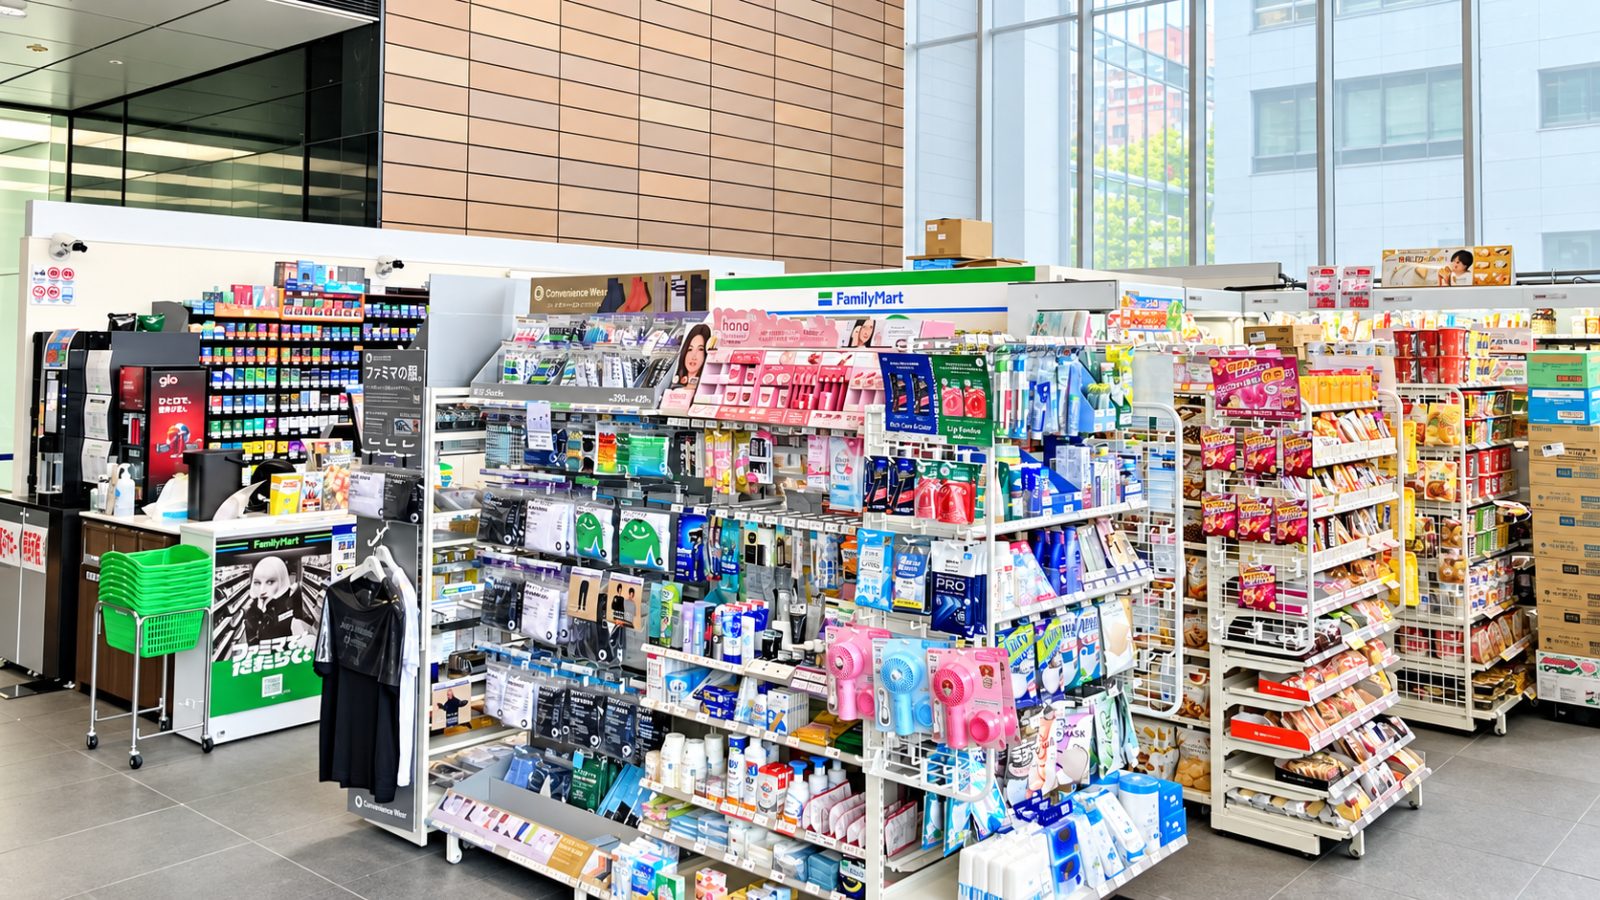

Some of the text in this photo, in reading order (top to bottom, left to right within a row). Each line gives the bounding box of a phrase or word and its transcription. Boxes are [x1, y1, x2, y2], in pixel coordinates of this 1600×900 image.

[545, 288, 588, 298] Convenience
[836, 290, 904, 308] FamilyMart
[722, 319, 749, 332] hana
[159, 373, 178, 388] glo
[253, 536, 299, 549] FamilyMart
[936, 578, 966, 591] PRO
